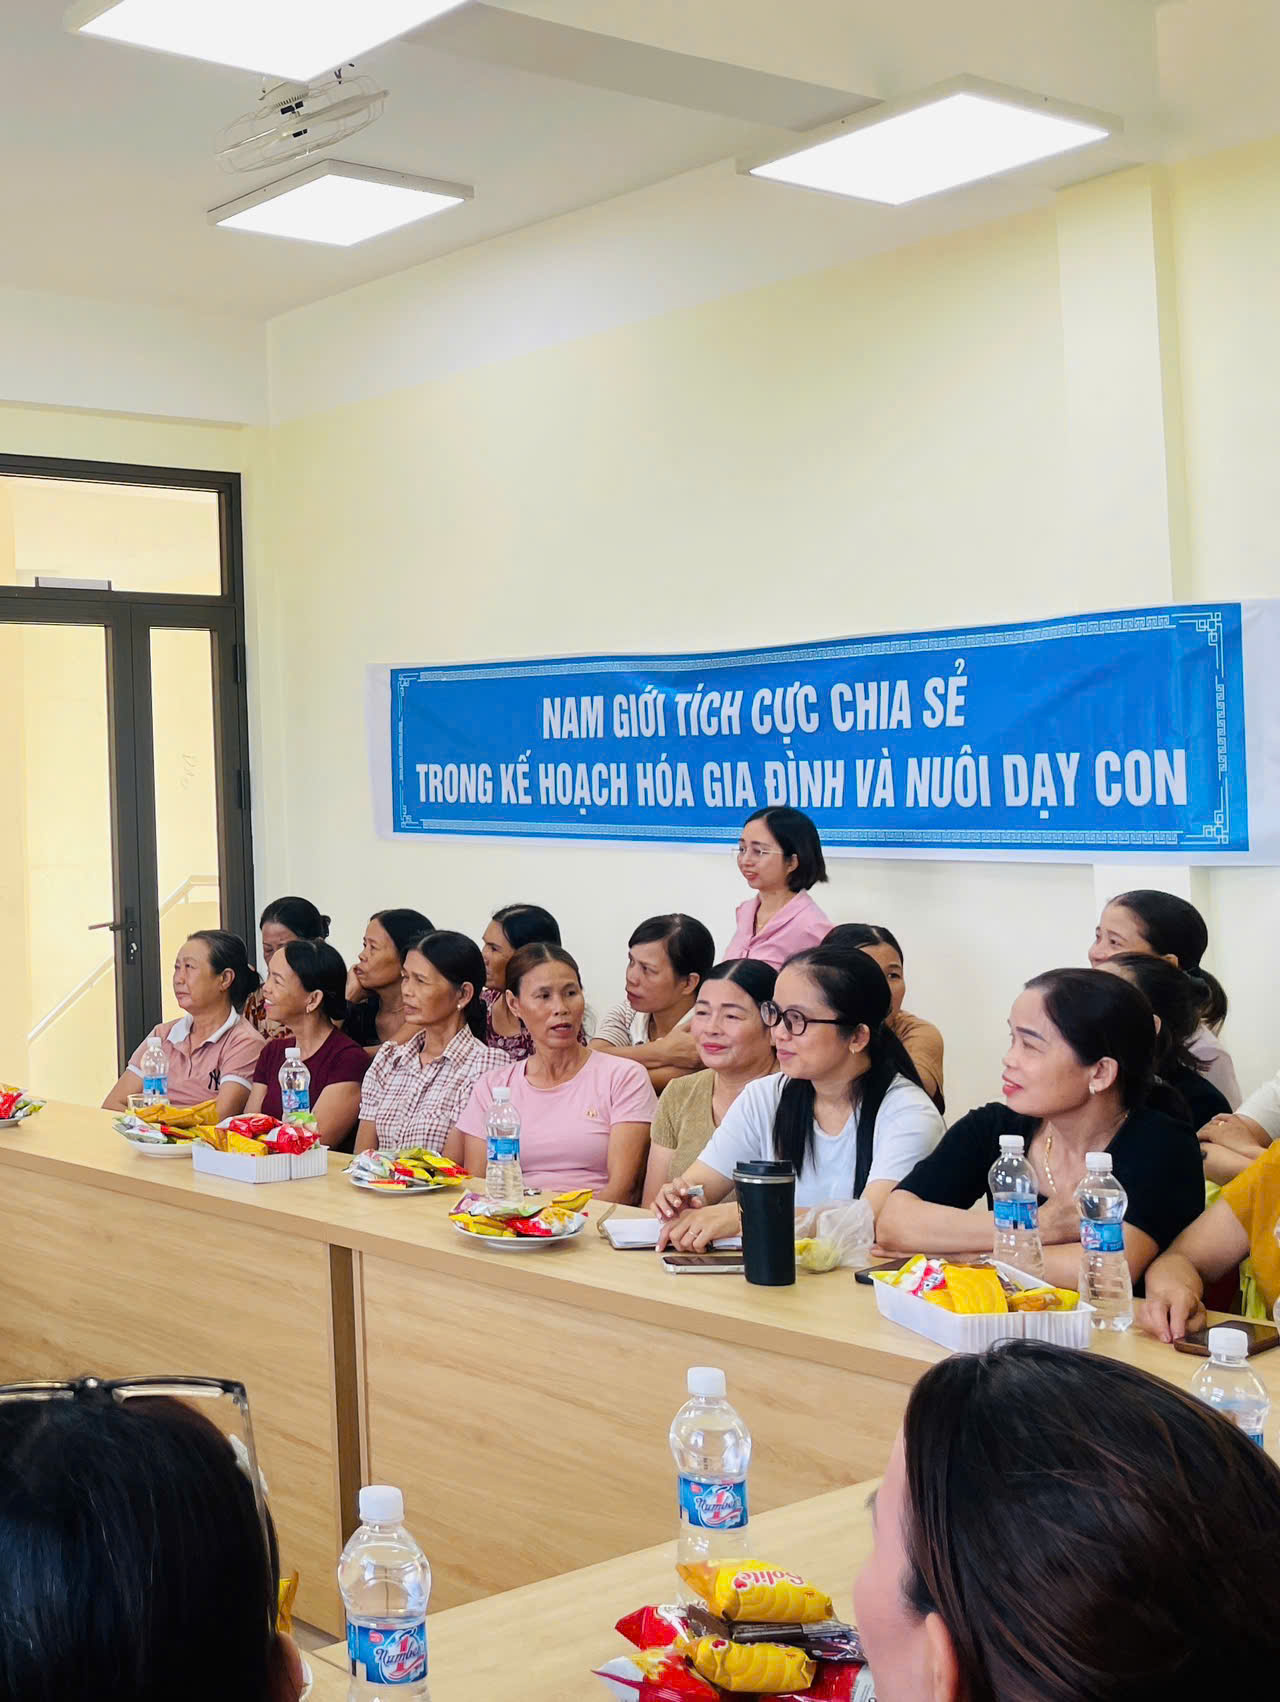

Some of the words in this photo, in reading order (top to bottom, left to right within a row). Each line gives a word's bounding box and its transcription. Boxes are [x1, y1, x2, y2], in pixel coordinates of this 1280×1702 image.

[544, 696, 603, 738] NAM
[614, 686, 665, 737] GIỚI
[675, 684, 743, 736] TÍCH
[752, 682, 818, 744] CỰC
[831, 681, 911, 731] CHIA
[924, 659, 967, 728] SẺ
[416, 764, 492, 803] TRONG
[501, 751, 531, 803] KẾ
[539, 763, 627, 814] HOẠCH
[637, 754, 694, 806] HÓA
[704, 762, 756, 807] GIA
[765, 751, 844, 807] ĐÌNH
[856, 748, 894, 807] VÀ
[907, 745, 990, 807] NUÔI
[1004, 753, 1079, 818] DẠY
[1096, 750, 1186, 806] CON
